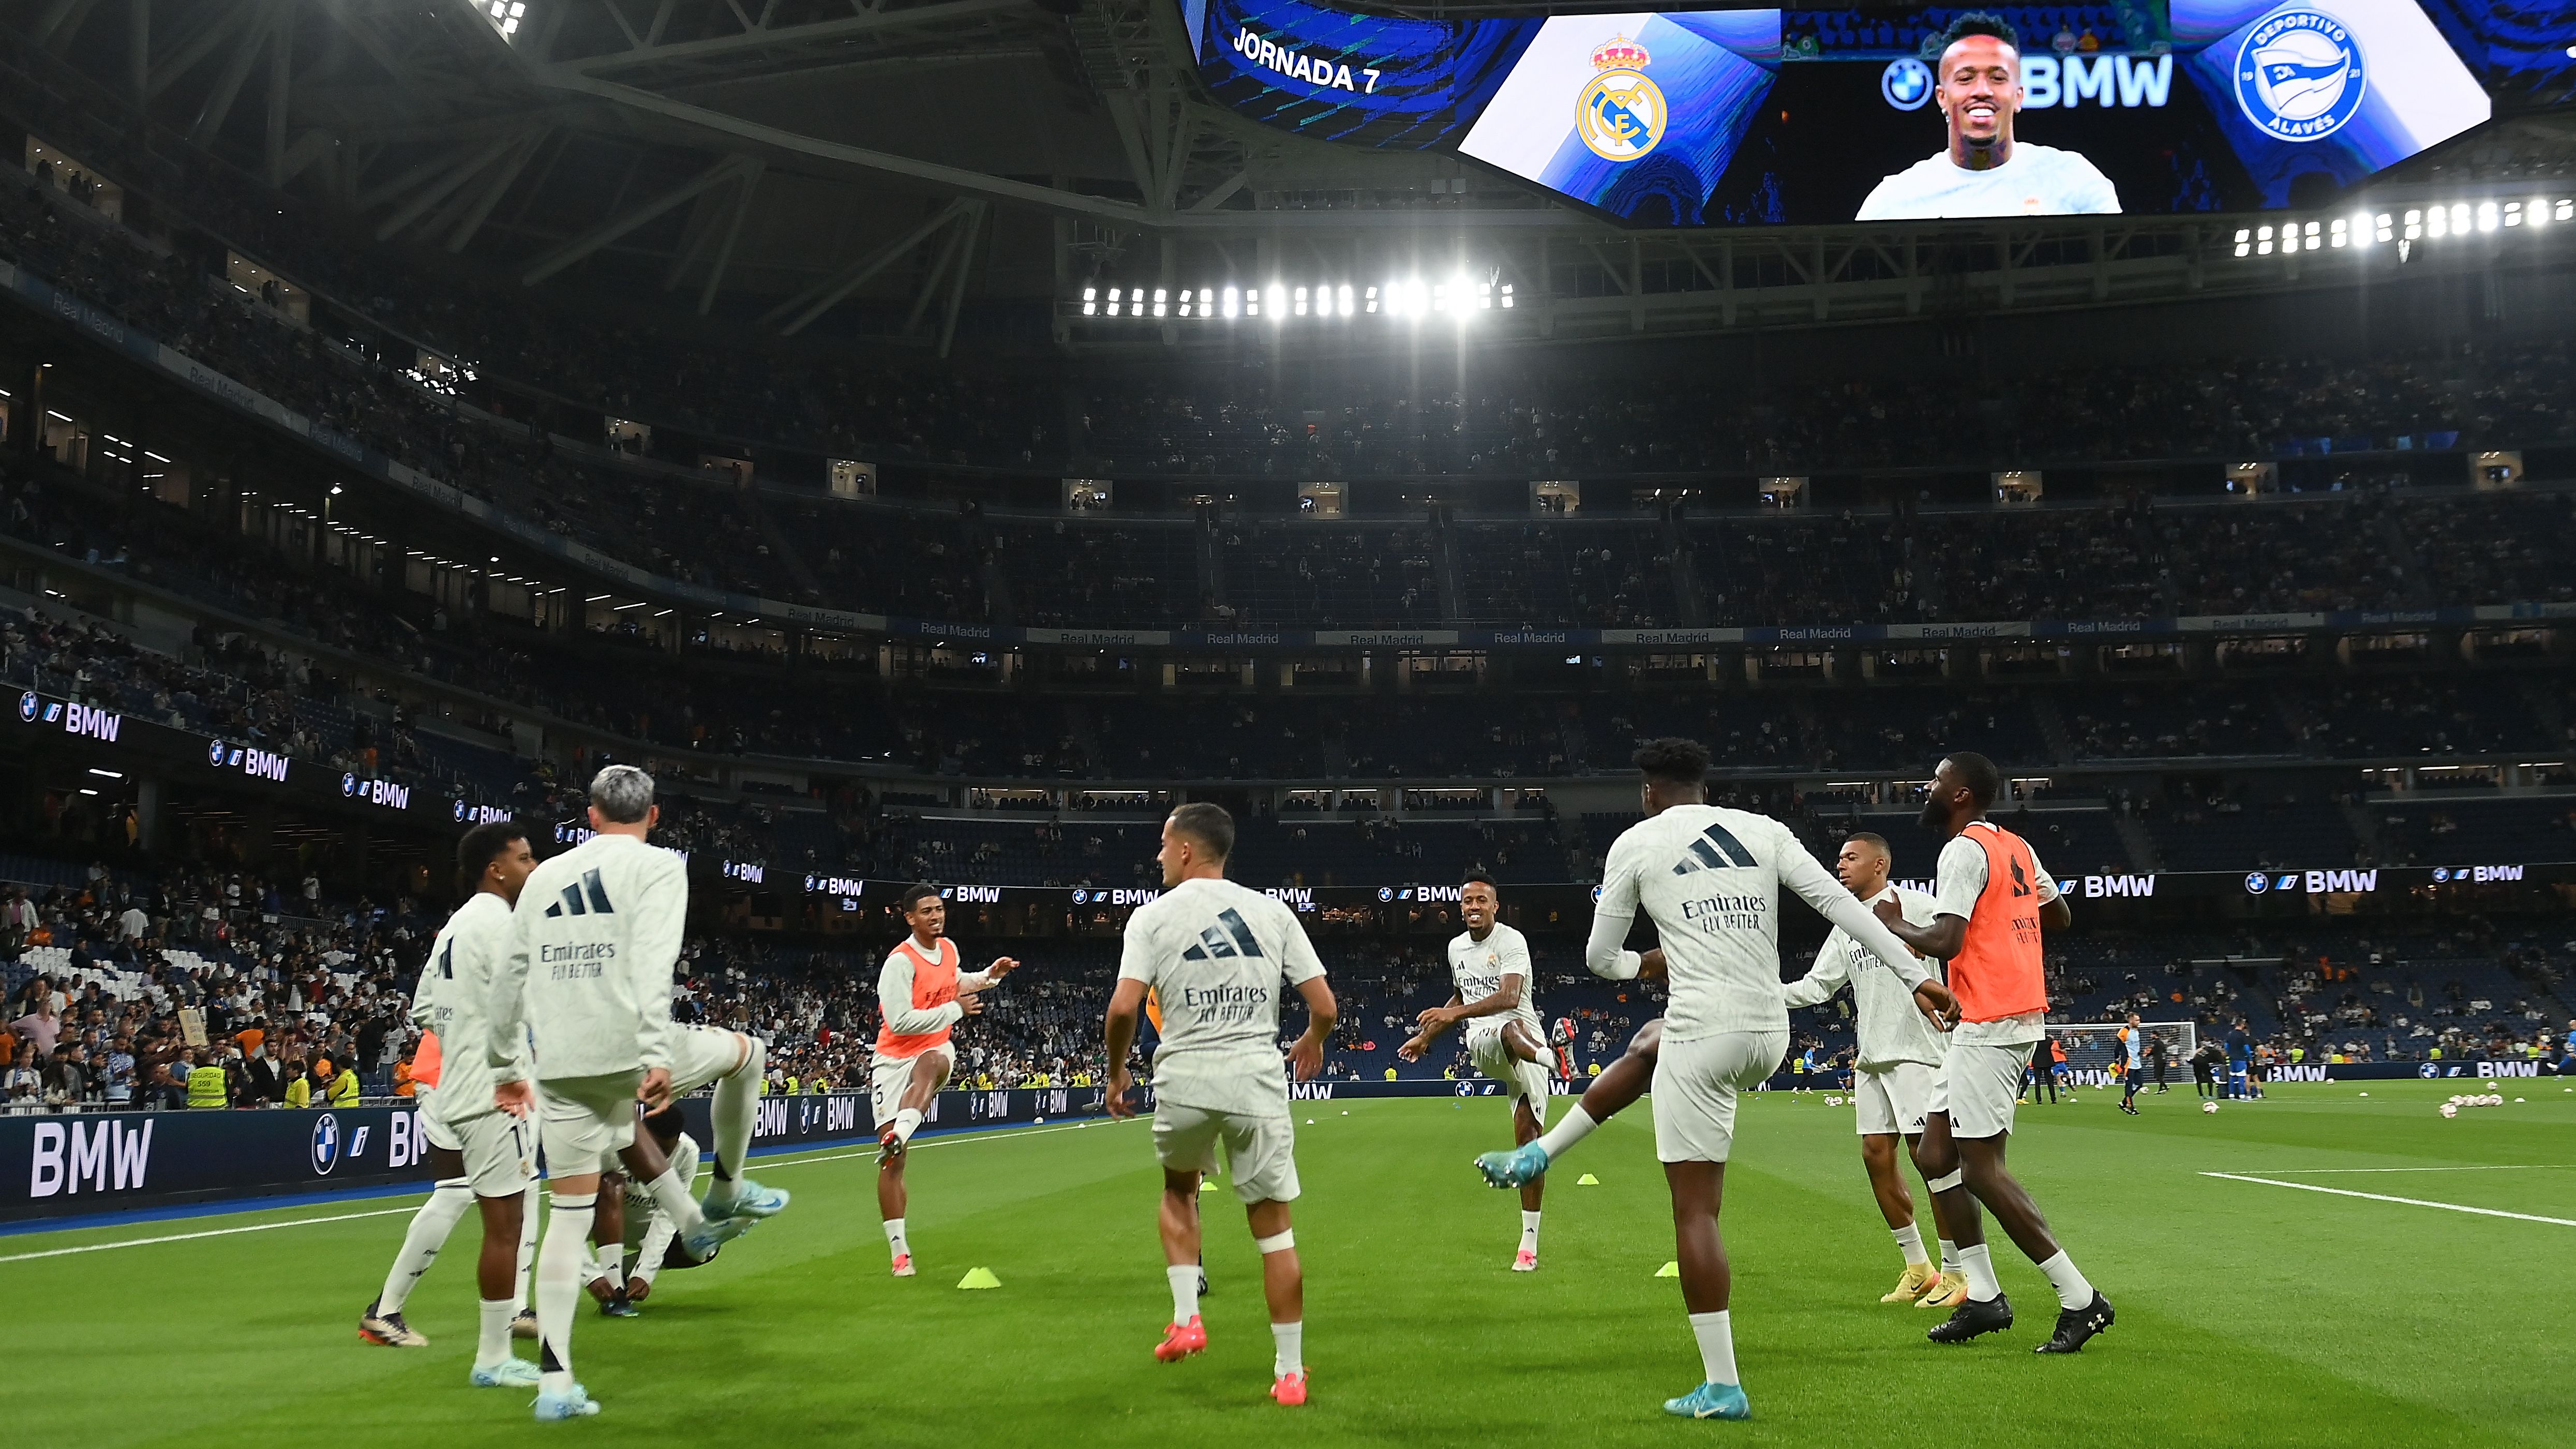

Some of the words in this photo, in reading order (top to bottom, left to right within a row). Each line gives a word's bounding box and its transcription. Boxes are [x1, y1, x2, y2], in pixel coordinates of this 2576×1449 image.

[2254, 14, 2346, 46] DEPORTIVO
[1233, 27, 1355, 92] JORNADA
[1363, 68, 1380, 94] 7
[2019, 54, 2173, 109] BMW
[2268, 114, 2336, 136] ALAVÉS
[788, 609, 813, 623] Real
[816, 612, 855, 626] Madrid
[2068, 622, 2094, 632] Real
[2098, 621, 2140, 632] Madrid
[921, 622, 946, 635] Real
[950, 625, 990, 639] Madrid
[1061, 633, 1088, 644] Real
[1092, 634, 1135, 645] Madrid
[1207, 633, 1233, 645] Real
[1237, 633, 1279, 645] Madrid
[1494, 633, 1520, 644] Real
[1524, 632, 1565, 644] Madrid
[1636, 633, 1663, 644] Real
[1667, 632, 1709, 644] Madrid
[1779, 629, 1806, 639] Real
[1810, 627, 1851, 639] Madrid
[1923, 628, 1949, 638] Real
[1953, 626, 1996, 637] Madrid
[1351, 635, 1377, 646] Real
[1381, 635, 1424, 646] Madrid
[66, 702, 121, 742] BMW
[245, 748, 289, 782] BMW
[372, 779, 410, 810] BMW
[577, 828, 597, 847] BM
[741, 863, 763, 884] BMW
[2305, 869, 2378, 893] BMW
[2473, 865, 2524, 882] BMW
[829, 877, 863, 896] BMW
[956, 886, 1000, 903] BMW
[1265, 888, 1312, 903] BMW
[1417, 886, 1462, 902] BMW
[2085, 874, 2155, 898] BMW
[1112, 889, 1159, 904] BMW
[1682, 893, 1766, 920] Emirates
[1703, 917, 1720, 933] FLY
[1725, 914, 1760, 930] BETTER
[542, 941, 616, 963] Emirates
[1185, 984, 1267, 1006] Emirates
[1220, 1006, 1254, 1021] BETTER
[2477, 1061, 2539, 1078] BMW
[1050, 1089, 1068, 1113] BMW
[1294, 1083, 1333, 1100] MW
[989, 1091, 1008, 1118] BMW
[754, 1098, 789, 1137] BMW
[827, 1096, 856, 1131] BMW
[389, 1111, 429, 1168] BM
[29, 1118, 155, 1198] BMW
